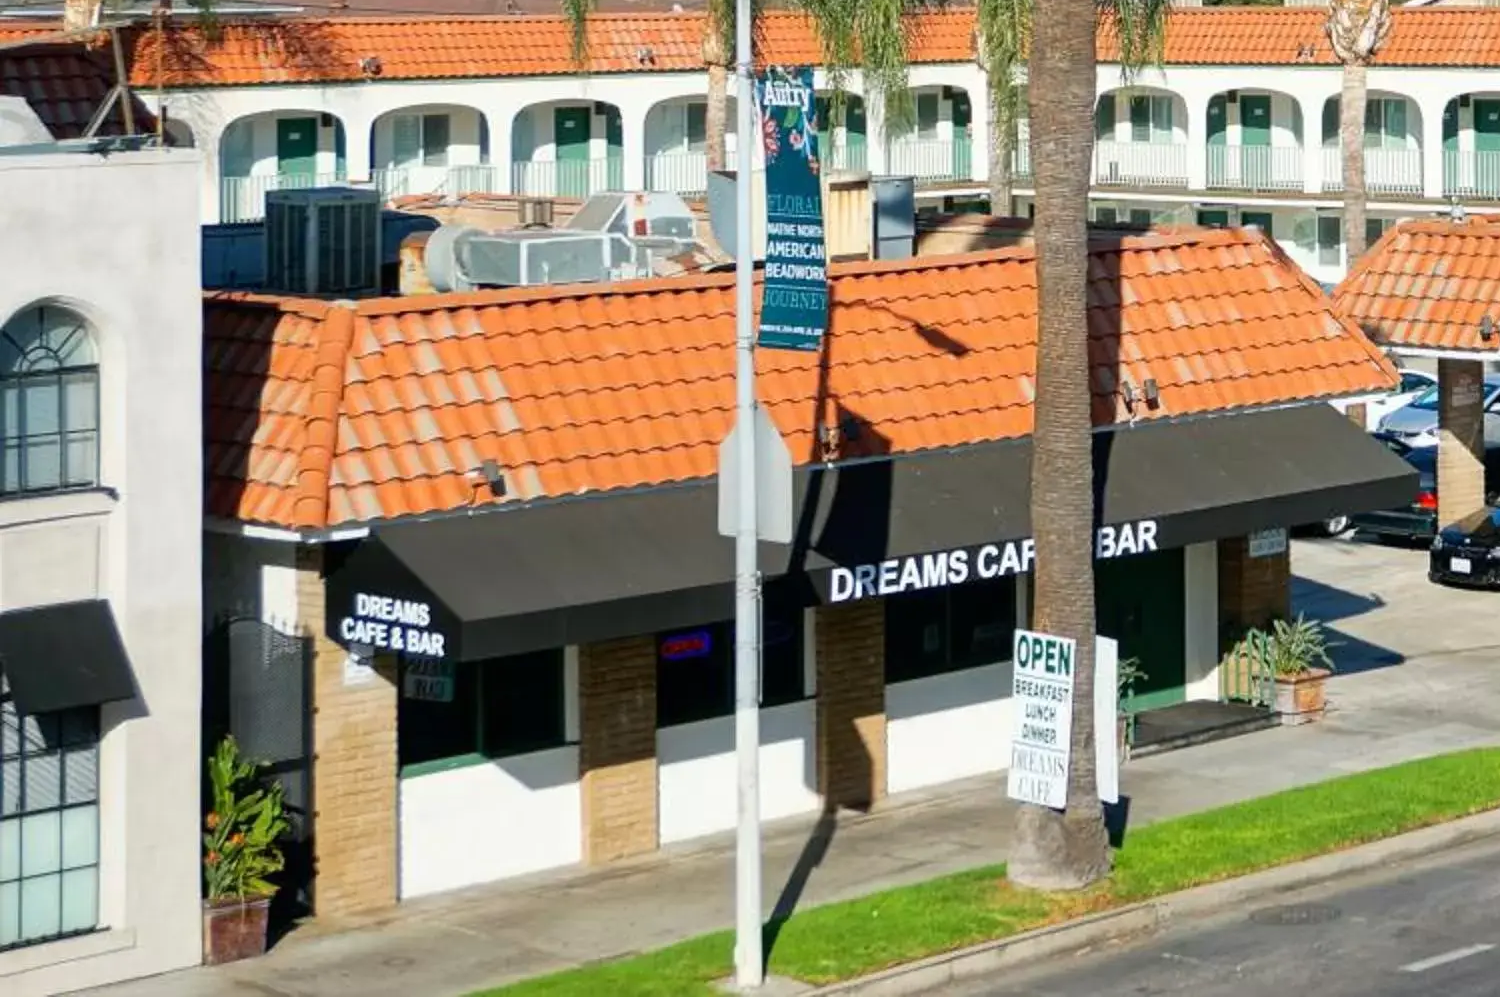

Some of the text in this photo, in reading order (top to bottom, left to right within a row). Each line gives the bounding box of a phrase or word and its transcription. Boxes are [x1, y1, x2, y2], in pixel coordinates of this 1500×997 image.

[763, 80, 812, 111] Autry
[767, 240, 824, 259] AMERICAN
[765, 262, 826, 281] BEADWORK
[830, 520, 1158, 603] DREAMS CAF BAR
[356, 592, 431, 627] DREAMS
[340, 616, 446, 658] CAFE & BAR
[1017, 634, 1071, 677] OPEN
[1015, 678, 1069, 702] BREAKFAST
[1025, 703, 1057, 723] LUNCH
[1021, 723, 1057, 744] DINNER
[1010, 743, 1066, 778] DREAMS
